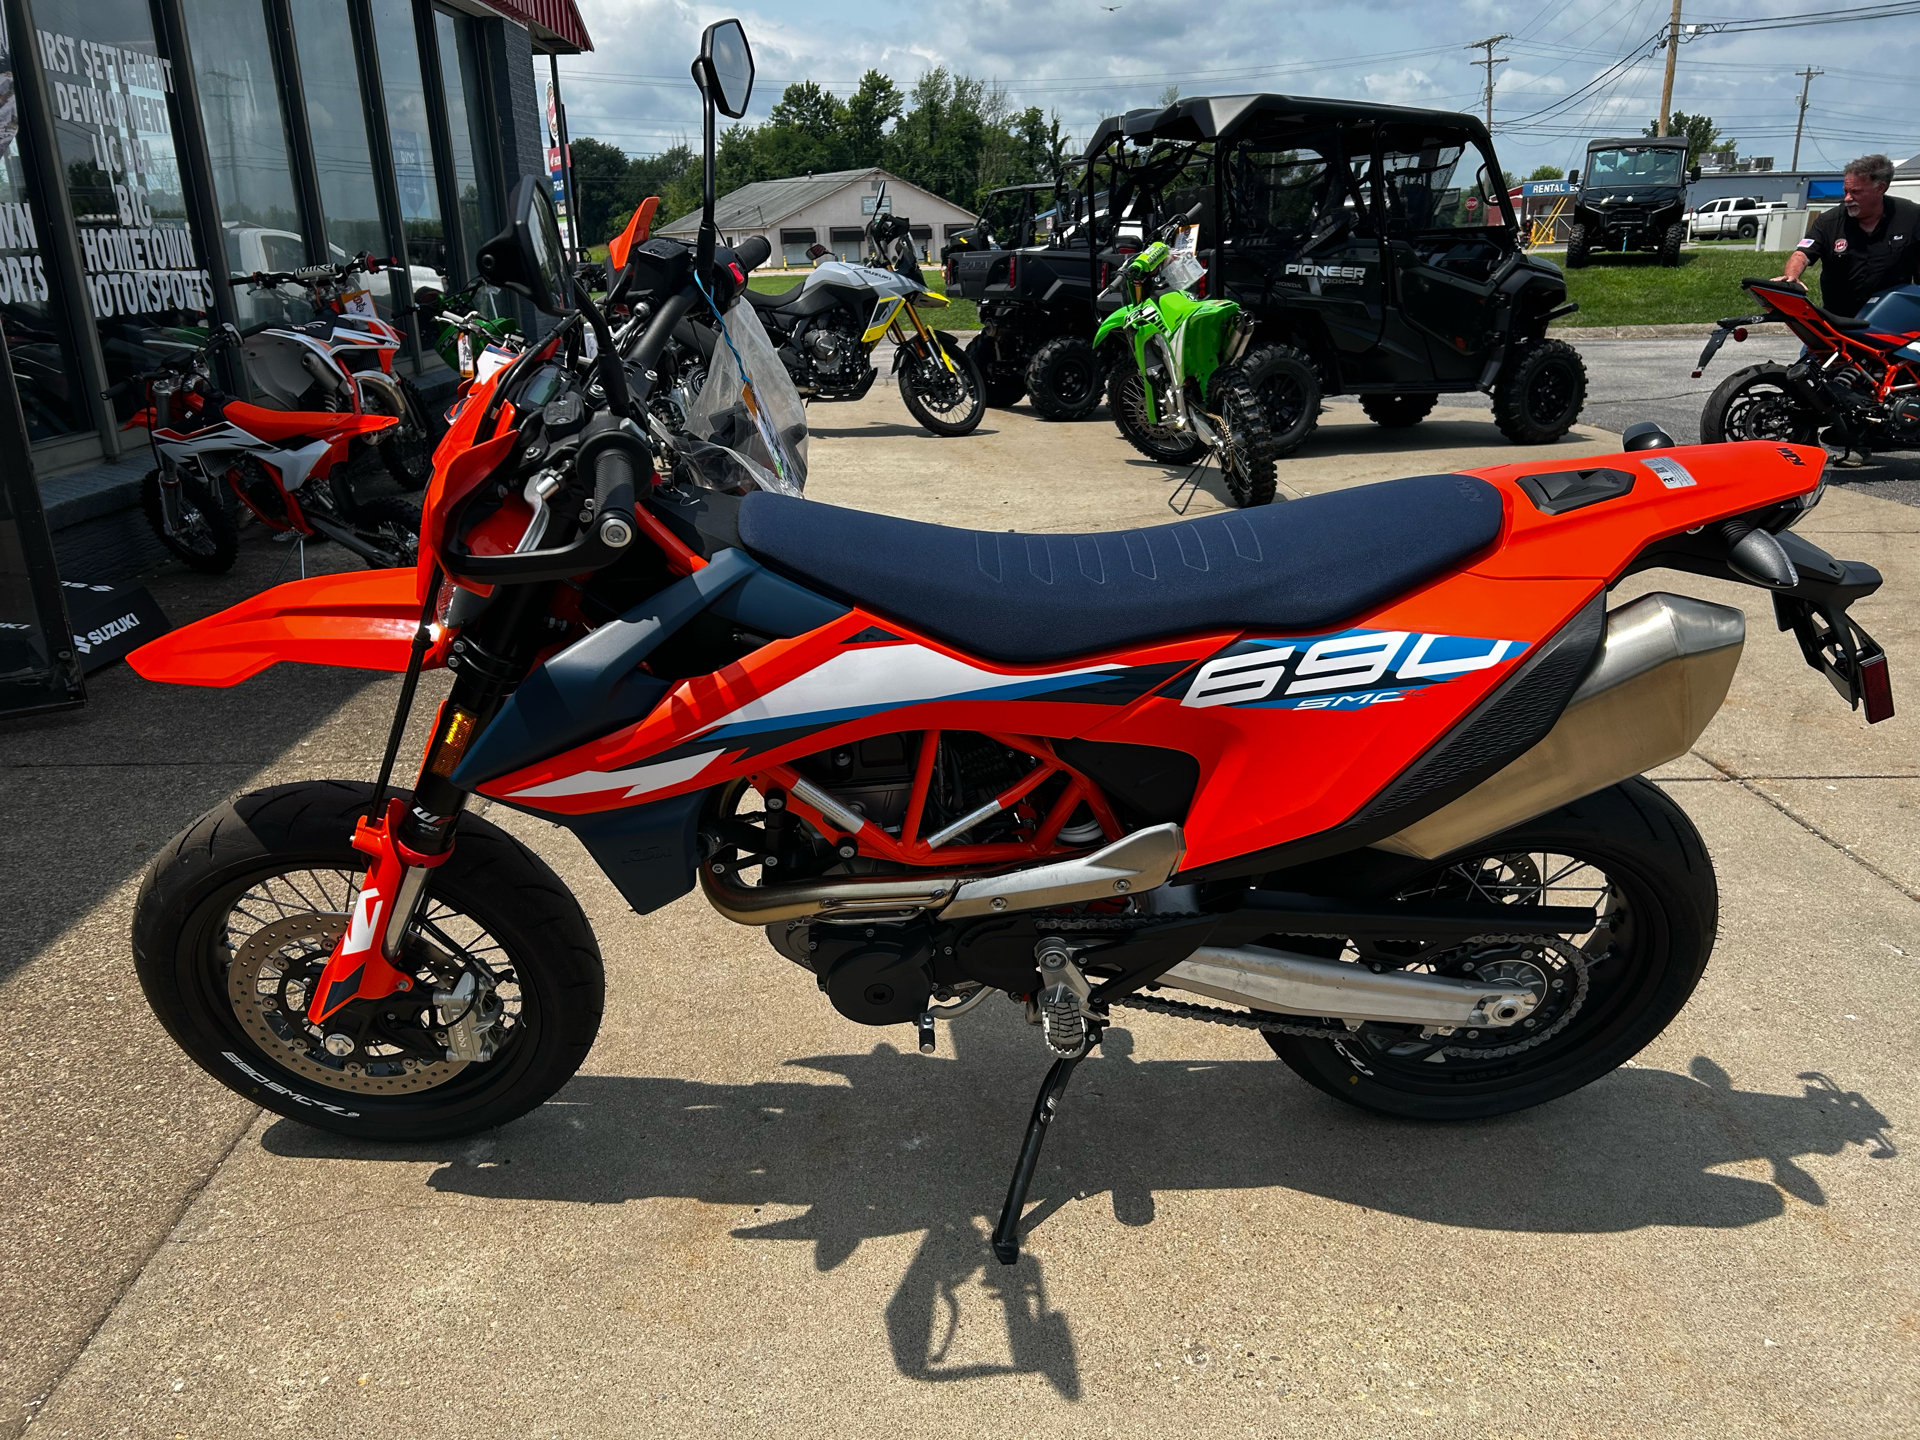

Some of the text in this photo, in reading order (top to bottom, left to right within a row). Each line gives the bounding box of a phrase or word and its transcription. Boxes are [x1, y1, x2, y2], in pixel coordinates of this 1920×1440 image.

[80, 39, 174, 94] SETTLEMENT
[54, 81, 170, 134] DEVELOPMENT
[91, 133, 154, 176] LLC DBA
[115, 184, 150, 227] BIG
[1533, 184, 1565, 194] RENTAL
[81, 228, 196, 271] HOMETOWN
[863, 269, 892, 281] SUZUKI
[1275, 281, 1302, 289] HONDA
[1285, 263, 1366, 278] PIONEER
[87, 612, 140, 645] SUZUKI
[1180, 630, 1514, 709] 690
[1293, 691, 1405, 711] SMC
